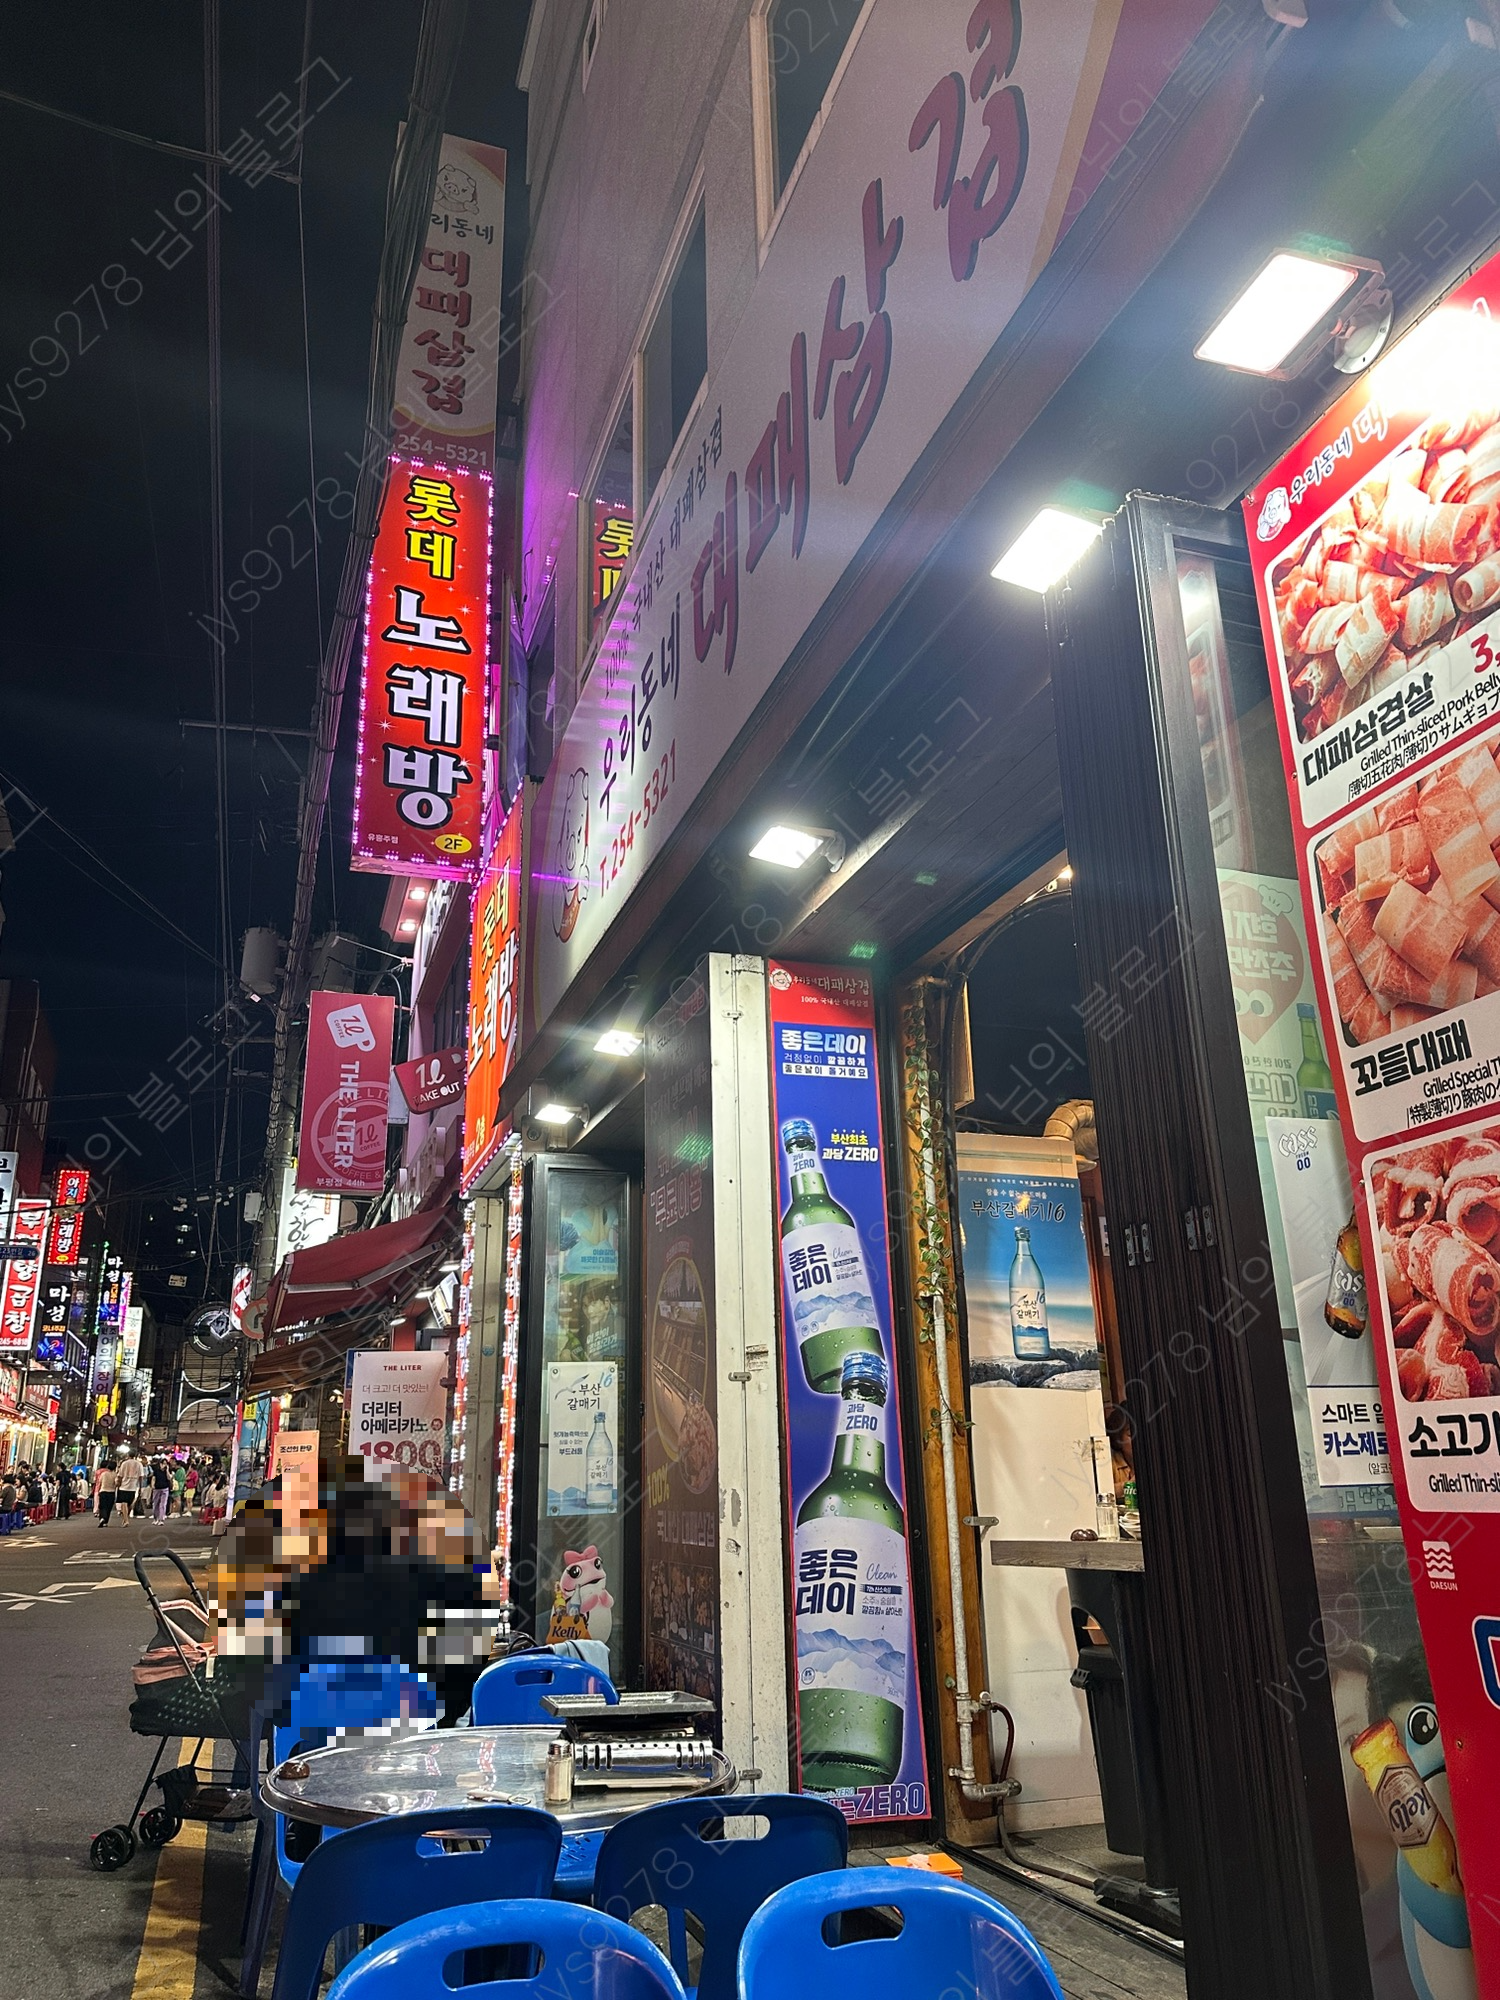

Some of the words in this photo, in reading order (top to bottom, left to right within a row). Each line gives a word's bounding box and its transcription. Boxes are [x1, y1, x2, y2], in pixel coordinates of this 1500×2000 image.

[431, 213, 494, 244] 리동네
[412, 246, 474, 415] 대패삼겹
[601, 591, 680, 824] 우리동네
[690, 0, 1029, 675] 대패삼겹
[1290, 425, 1353, 504] 우리동네
[405, 476, 461, 581] 롯데
[381, 586, 472, 831] 노래방
[1302, 671, 1435, 787] 대패삼겹살
[1360, 743, 1392, 772] Grilled
[1391, 704, 1448, 758] Thin-sliced
[1449, 689, 1476, 717] Pork
[600, 738, 677, 898] T.254-5321
[443, 836, 464, 853] 2F
[482, 862, 509, 971] 롯데
[818, 976, 870, 996] 대패삼겹
[467, 929, 518, 1077] 노래방
[801, 995, 819, 1004] 100%
[781, 1029, 867, 1055] 좋은데이
[1350, 1019, 1473, 1097] 꼬들대패
[338, 1060, 359, 1101] THE
[439, 1081, 461, 1098] OUT
[1423, 1072, 1456, 1098] Grilled
[1454, 1059, 1493, 1090] Special
[333, 1106, 357, 1168] LITER
[830, 1133, 869, 1147] 부산최초
[793, 1158, 816, 1174] ZERO
[822, 1147, 844, 1160] 과당
[844, 1147, 880, 1163] ZERO
[316, 1177, 344, 1187] 부평점
[788, 1243, 829, 1273] 좋은
[791, 1263, 833, 1295] 데이
[1022, 1300, 1038, 1310] 부산
[362, 1384, 371, 1393] 더
[393, 1384, 401, 1393] 더
[578, 1383, 602, 1396] 부산
[361, 1400, 402, 1418] 더리터
[567, 1397, 601, 1410] 갈매기
[846, 1403, 865, 1414] 과당
[1322, 1403, 1370, 1424] 스마트
[360, 1417, 428, 1435] 아메리카노
[845, 1414, 878, 1432] ZERO
[1429, 1473, 1462, 1494] Grilled
[799, 1549, 858, 1582] 좋은
[866, 1563, 898, 1581] Clean
[796, 1581, 857, 1617] 데이
[1430, 1581, 1459, 1591] DAESUN
[552, 1625, 582, 1640] Kelly
[856, 1782, 926, 1819] ZERO
[1388, 1788, 1432, 1833] Kelly
